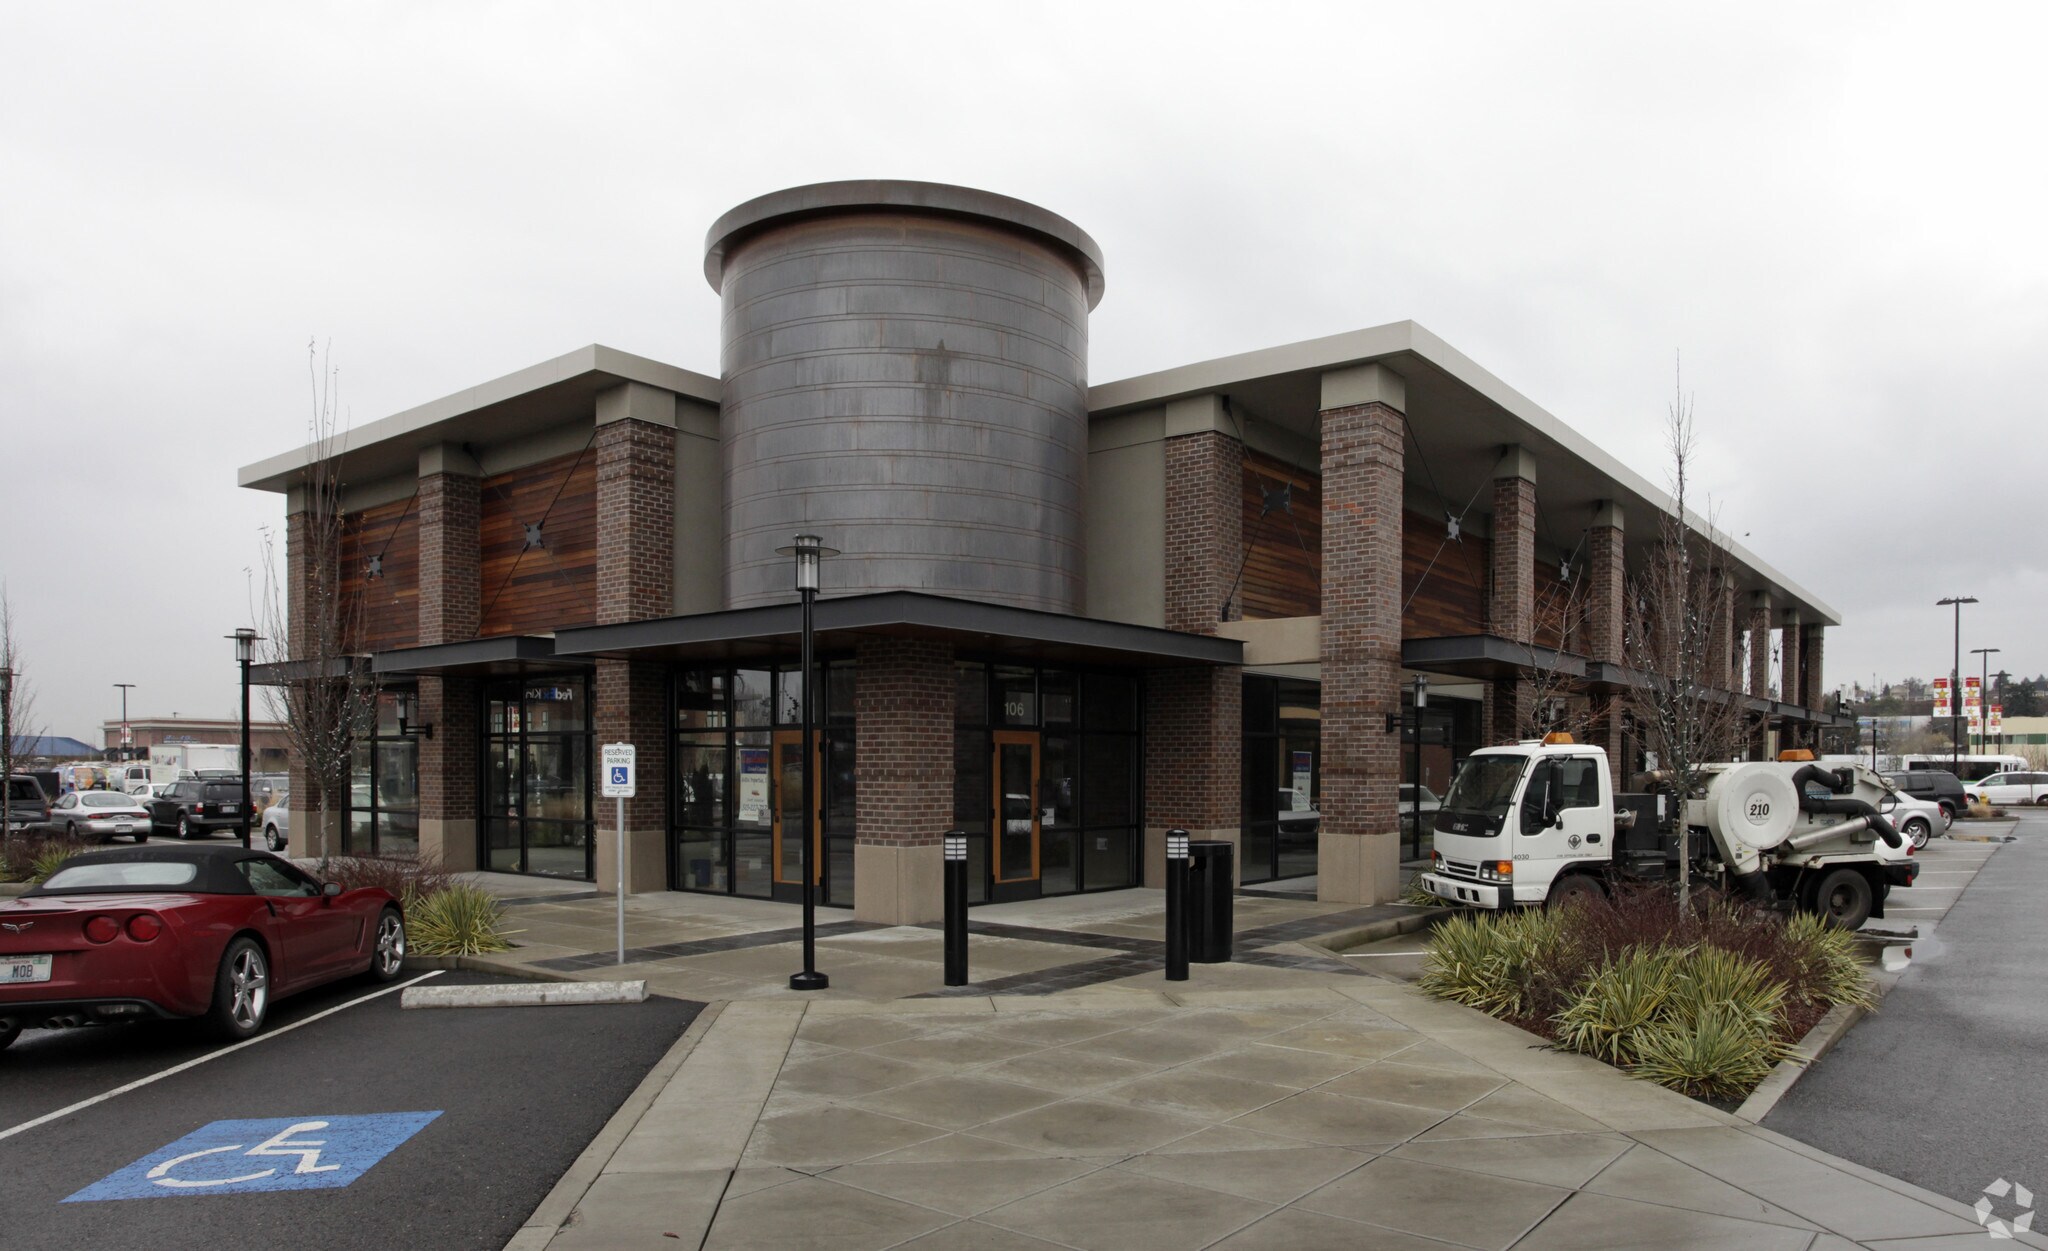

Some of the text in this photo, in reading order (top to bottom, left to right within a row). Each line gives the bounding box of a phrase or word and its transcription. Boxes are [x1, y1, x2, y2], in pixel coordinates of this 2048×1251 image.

[1004, 702, 1025, 717] 106
[1750, 803, 1770, 816] 210
[12, 964, 33, 978] MOB
